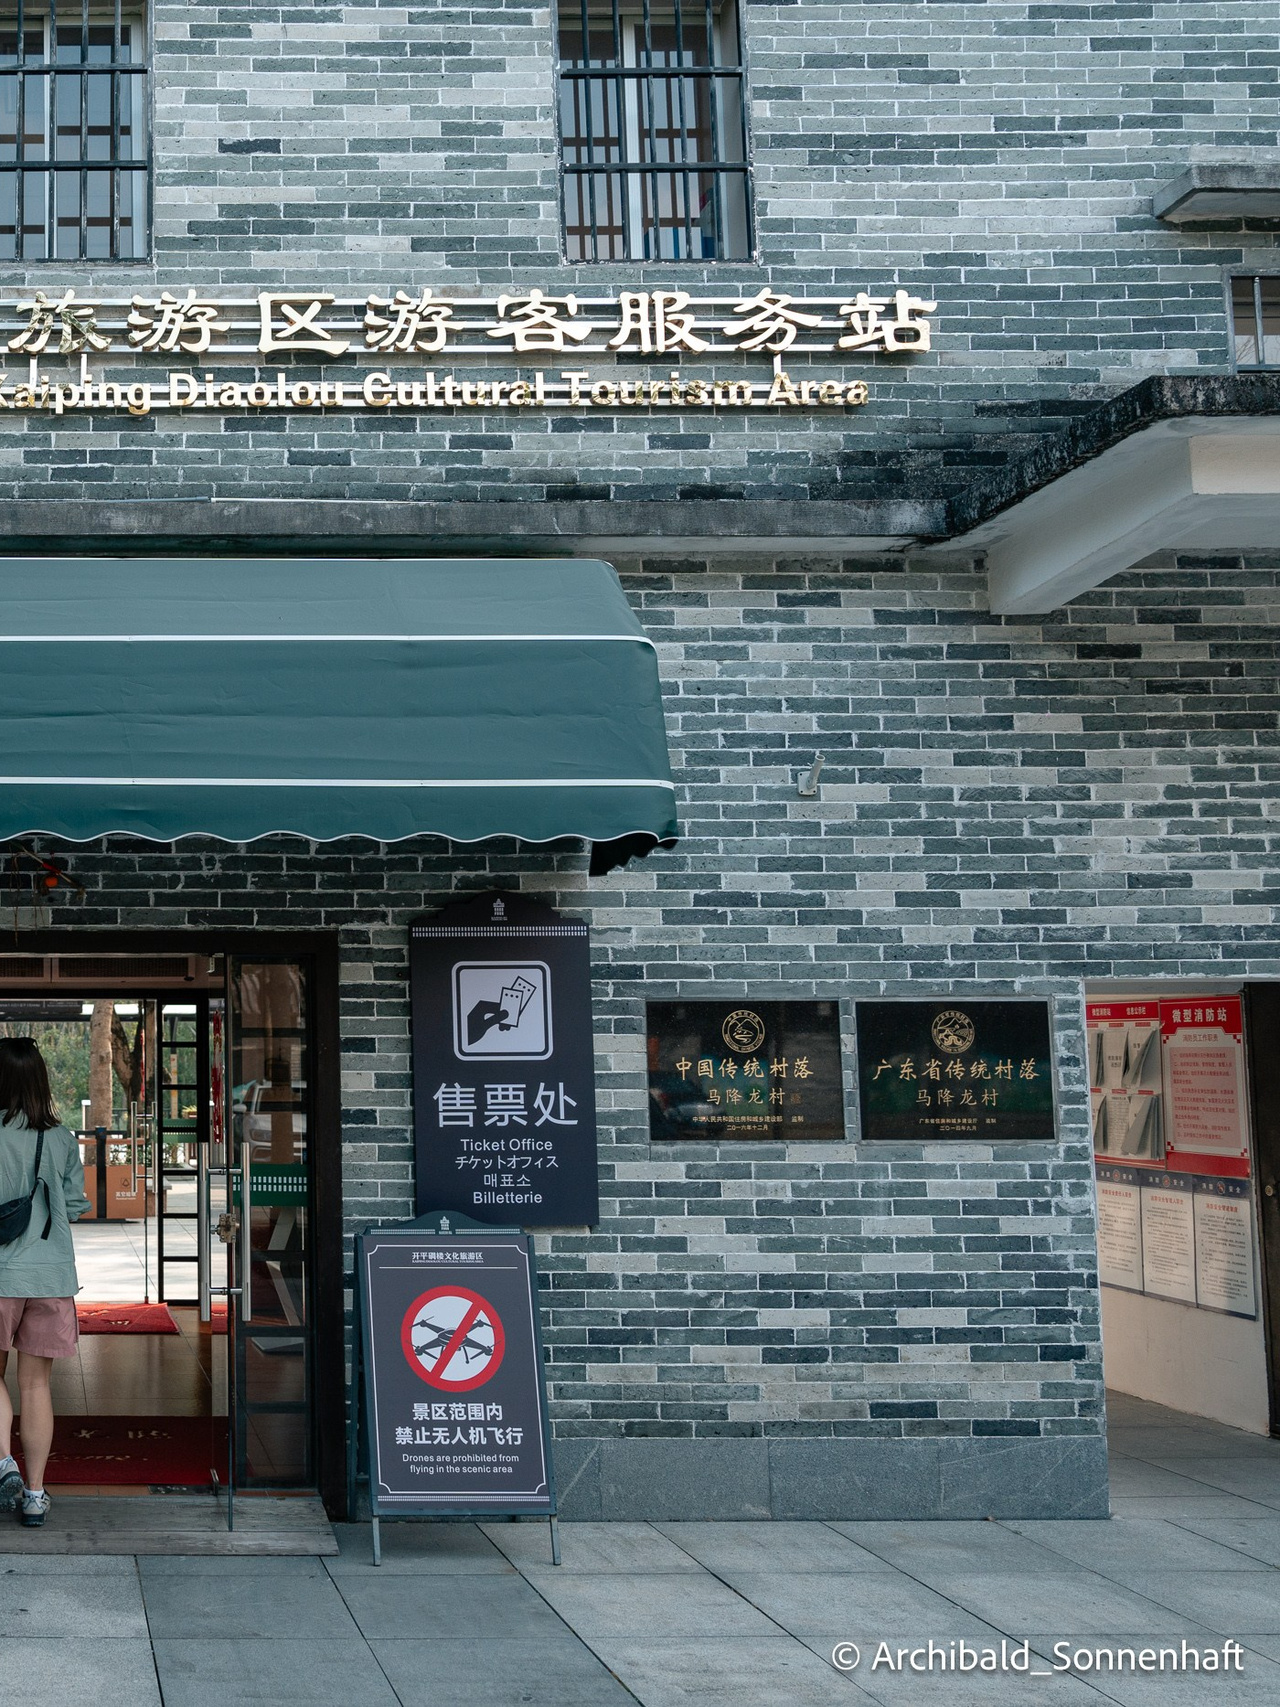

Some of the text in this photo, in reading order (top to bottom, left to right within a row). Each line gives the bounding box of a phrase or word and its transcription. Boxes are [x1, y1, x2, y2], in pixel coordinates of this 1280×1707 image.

[170, 373, 341, 407] Diaolou
[363, 372, 549, 407] Cultural
[561, 372, 753, 407] Tourism
[766, 372, 871, 406] Area
[1172, 1008, 1227, 1022] 微型消防站
[676, 1057, 814, 1080] 中国传统村落
[872, 1058, 1040, 1081] 广东省传统村落
[433, 1082, 578, 1127] 售票处
[706, 1088, 785, 1105] 马降龙村
[915, 1088, 999, 1106] 马降龙村
[460, 1138, 553, 1152] Ticket Office
[455, 1155, 559, 1169] チケットオフィス
[483, 1173, 531, 1189] 매표소
[473, 1191, 542, 1204] Billetterie
[412, 1403, 503, 1420] 景区范围内
[395, 1427, 524, 1445] 禁止无人机飞行
[402, 1454, 434, 1463] Drones
[452, 1454, 498, 1466] prohibited
[498, 1454, 519, 1464] from
[410, 1465, 434, 1475] flying
[436, 1465, 444, 1474] in
[446, 1465, 460, 1474] the
[462, 1465, 491, 1474] scenic
